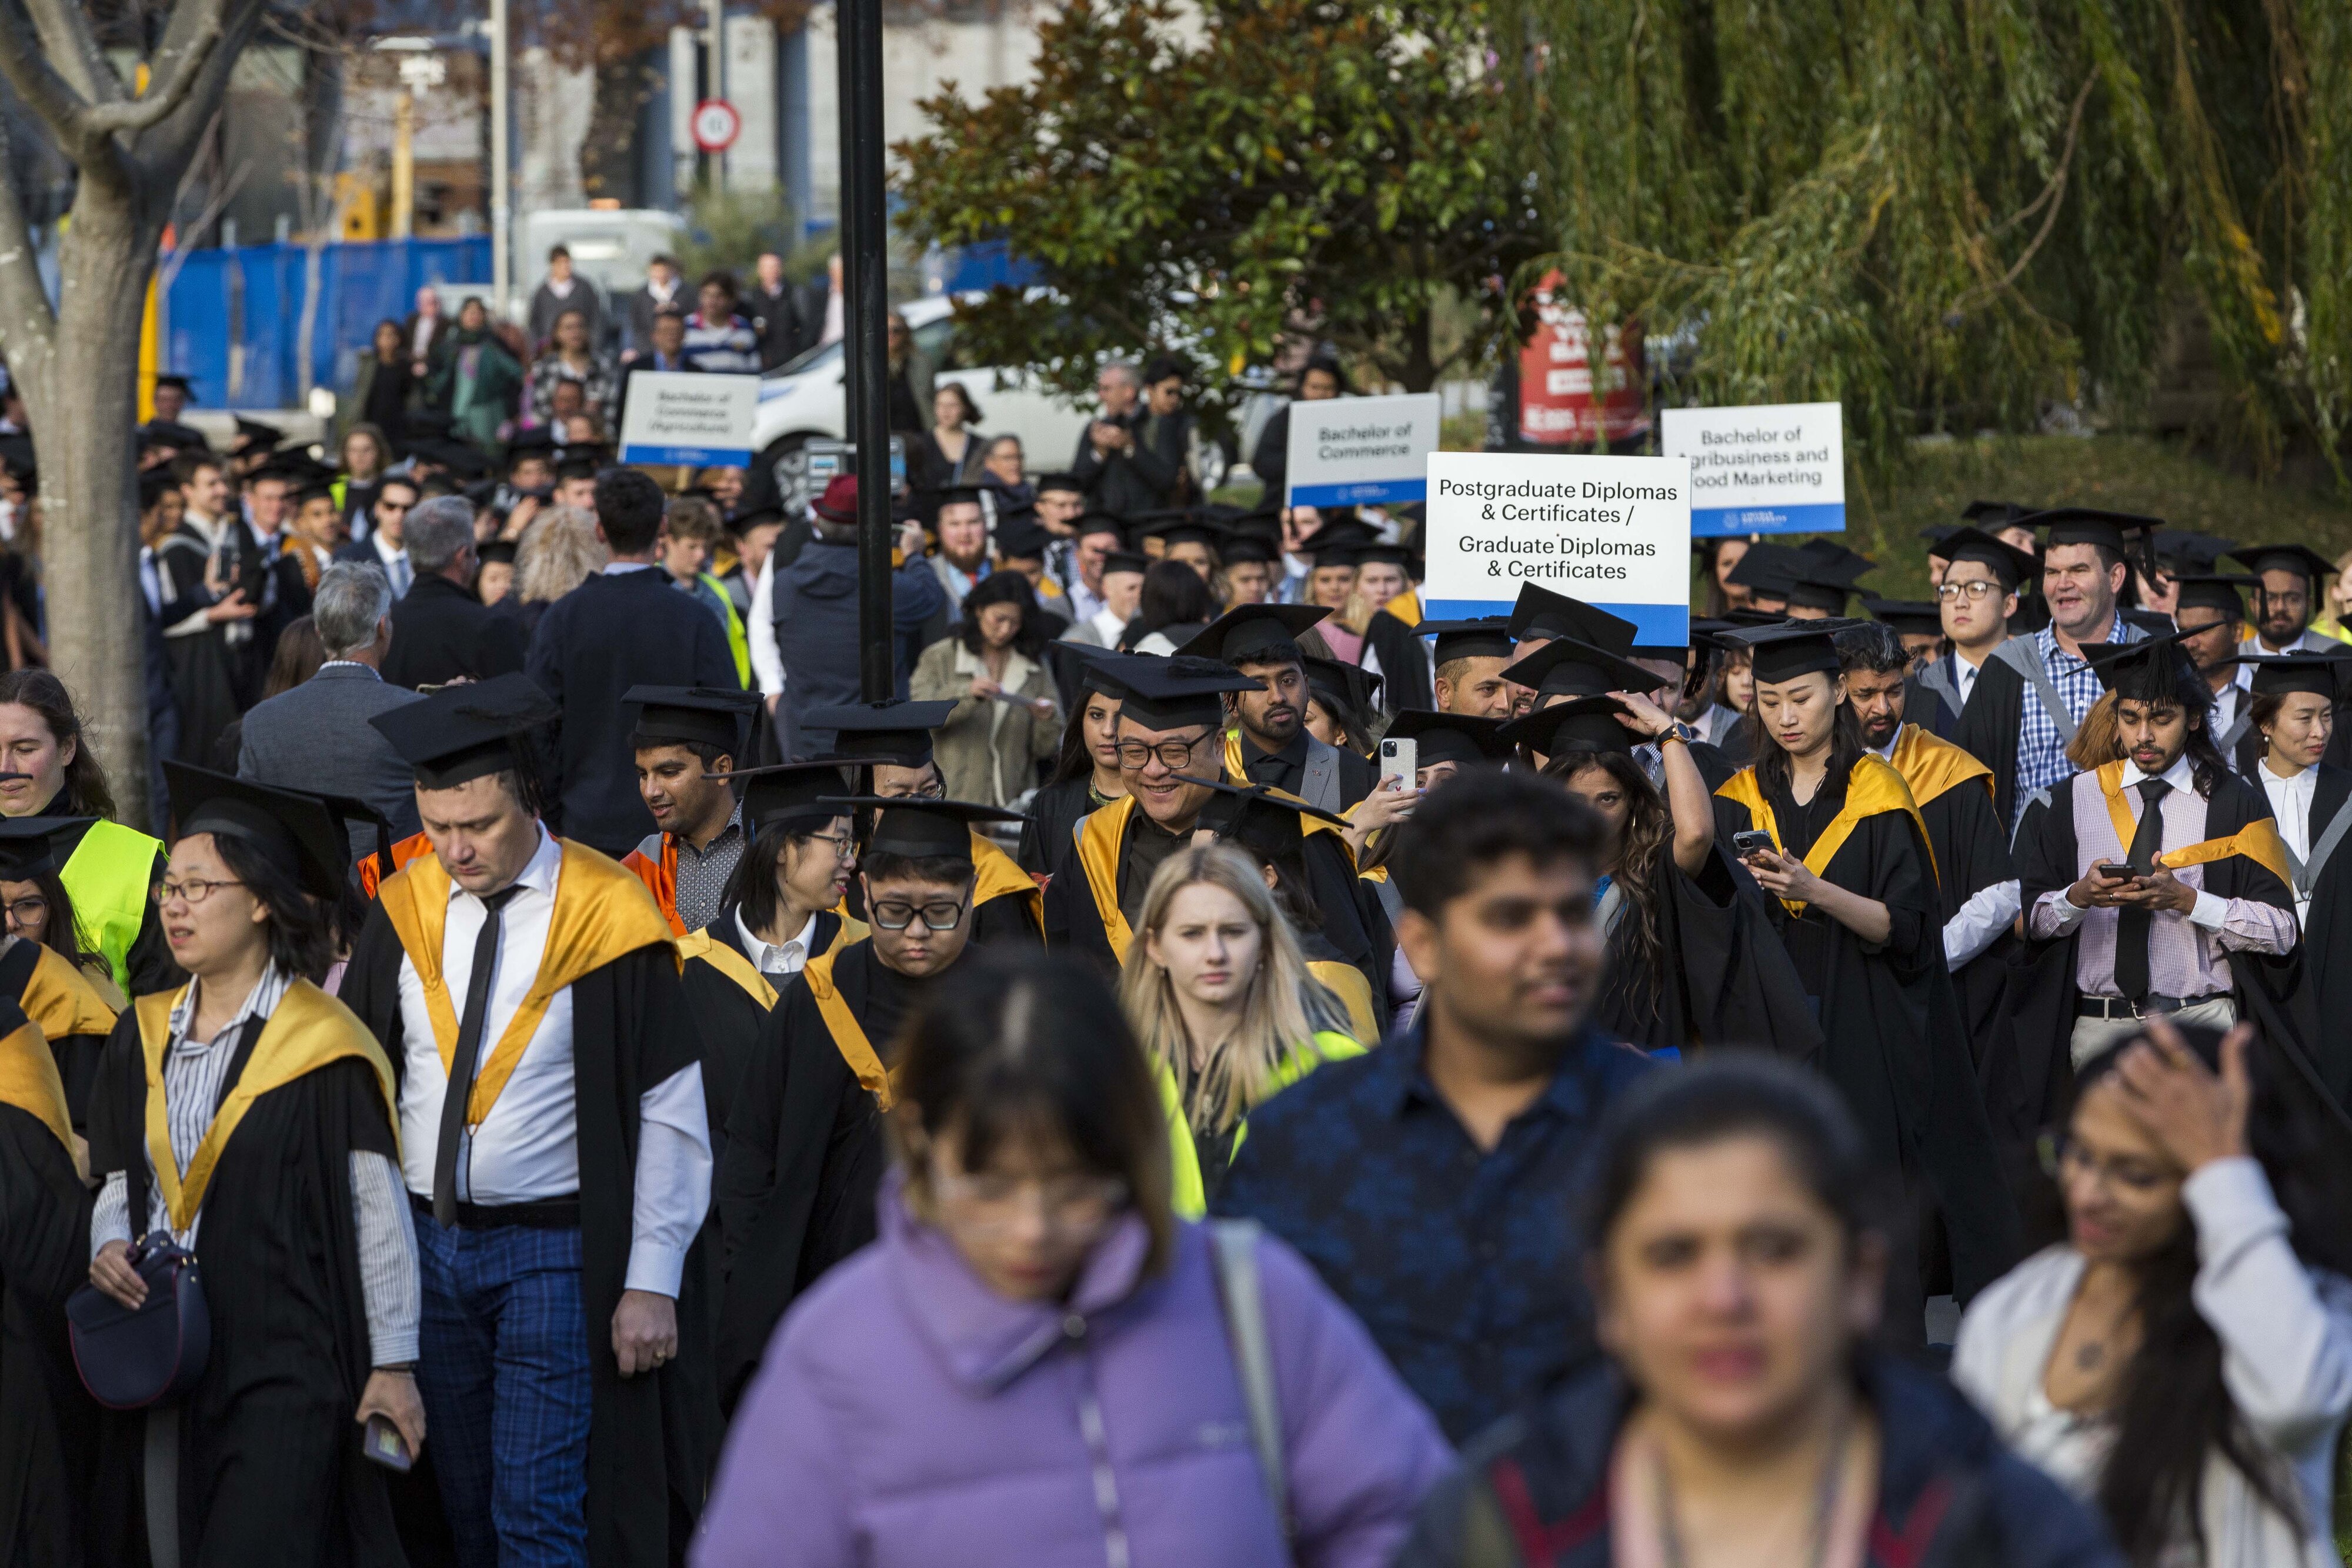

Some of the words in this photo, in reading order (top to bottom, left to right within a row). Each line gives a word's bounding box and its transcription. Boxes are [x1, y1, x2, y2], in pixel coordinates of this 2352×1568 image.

[1319, 426, 1390, 442] Bachelor
[1394, 422, 1412, 438] of
[1701, 428, 1778, 446] Bachelor
[1784, 426, 1801, 442] of
[1318, 443, 1411, 461] Commerce
[1680, 449, 1790, 470] gribusiness
[1796, 446, 1829, 462] and
[1691, 472, 1728, 488] ood
[1733, 469, 1823, 488] Marketing
[1440, 479, 1576, 501] Postgraduate
[1583, 482, 1677, 503] Diplomas
[1482, 503, 1496, 520] &
[1502, 504, 1620, 523] Certificates
[1626, 505, 1634, 526] /
[1459, 535, 1554, 554] Graduate
[1561, 538, 1656, 559] Diplomas
[1487, 560, 1502, 576] &
[1508, 560, 1627, 579] Certificates
